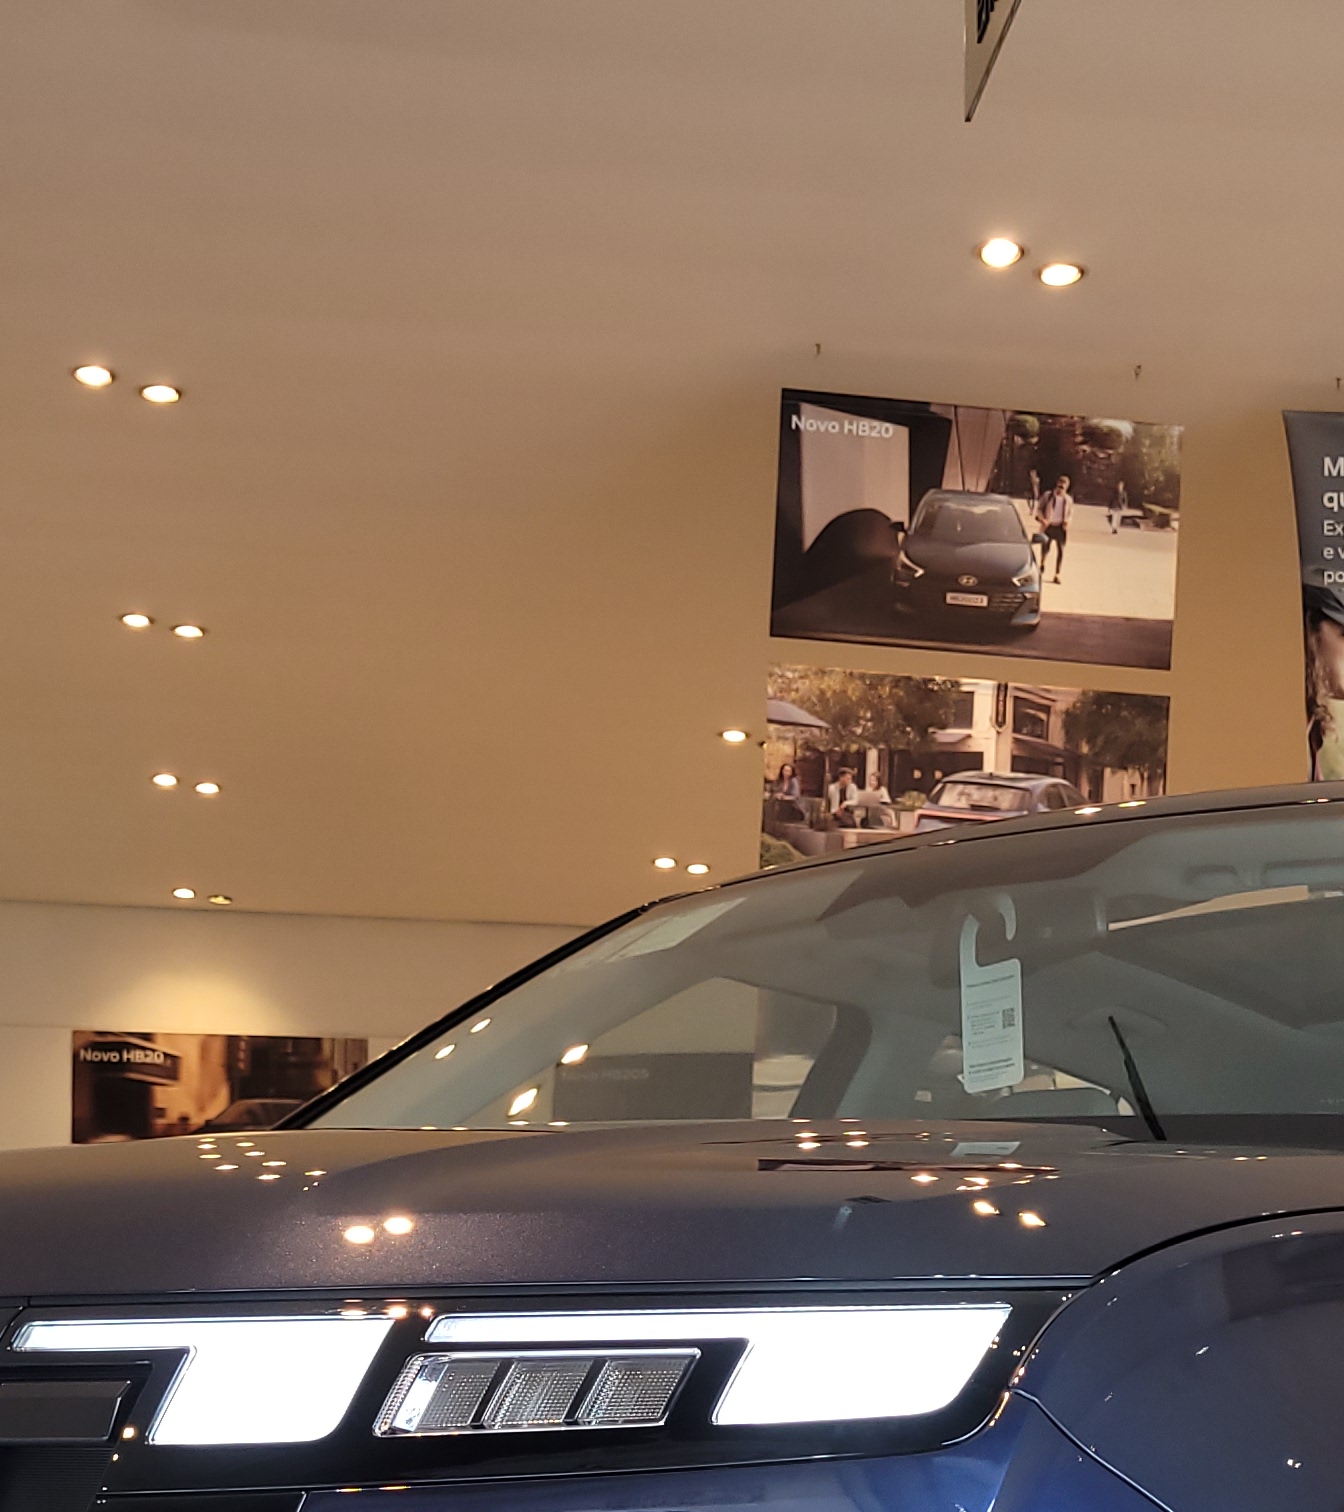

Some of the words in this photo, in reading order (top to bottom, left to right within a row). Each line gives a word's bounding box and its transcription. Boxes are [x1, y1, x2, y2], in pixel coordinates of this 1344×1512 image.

[790, 413, 840, 433] Novo
[843, 420, 894, 438] HB20
[1323, 548, 1335, 559] e
[79, 1047, 120, 1063] Novo
[122, 1048, 165, 1064] HB20
